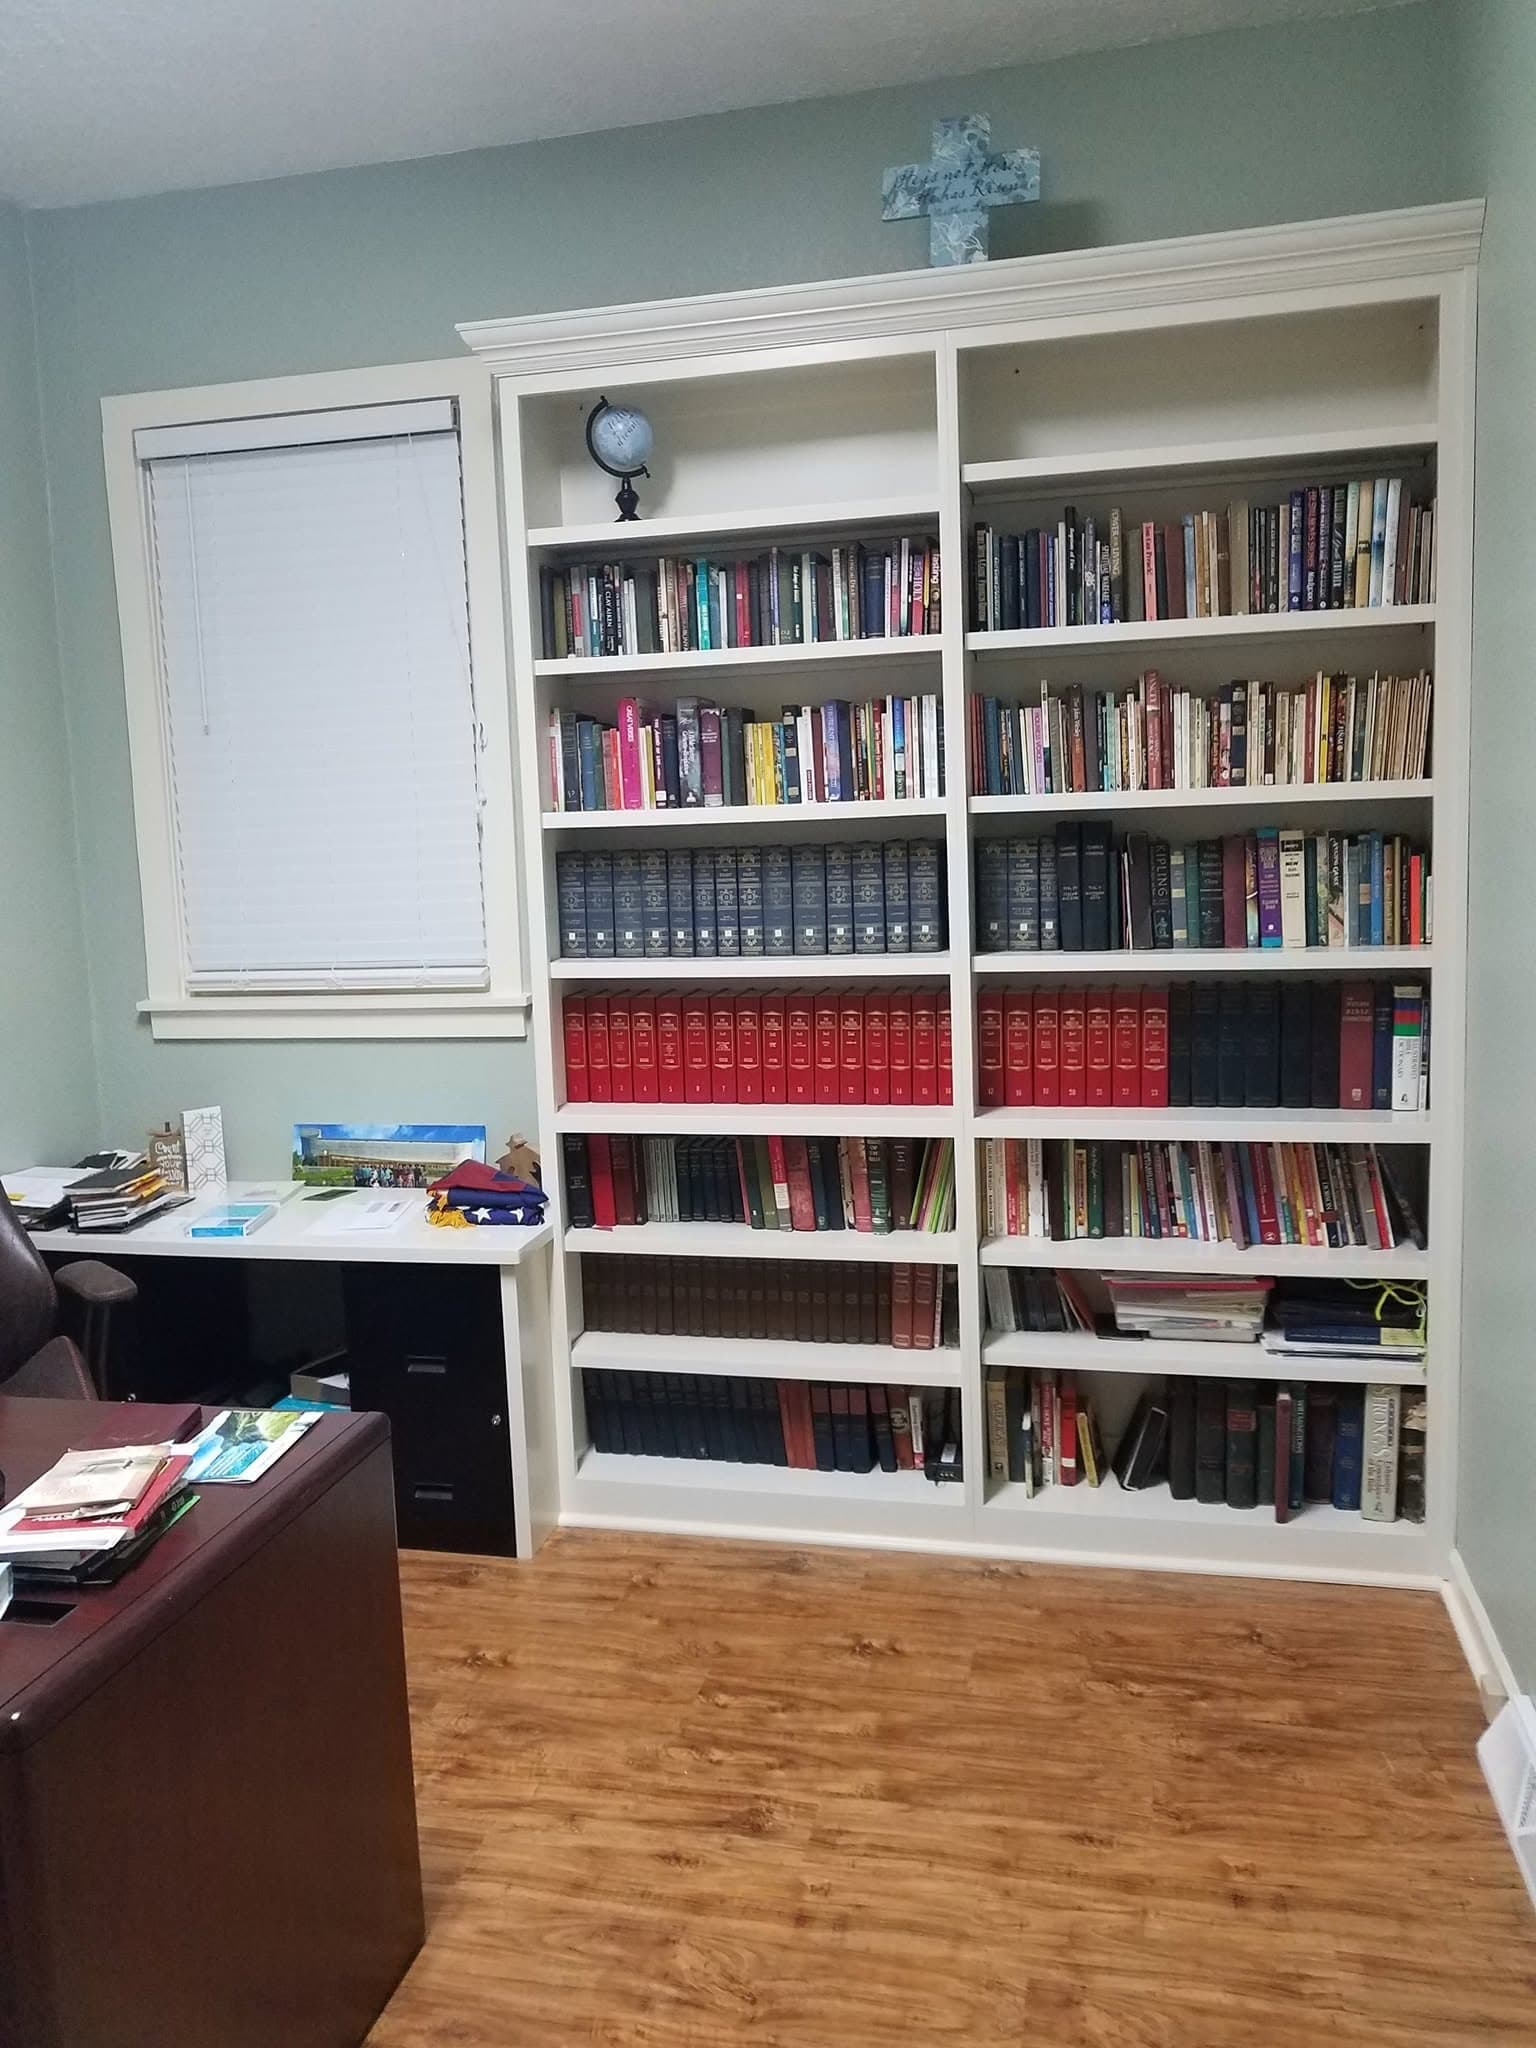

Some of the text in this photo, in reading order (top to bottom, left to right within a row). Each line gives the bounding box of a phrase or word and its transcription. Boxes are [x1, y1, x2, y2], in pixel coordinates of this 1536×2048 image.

[1112, 547, 1120, 575] LIVING
[604, 591, 613, 627] CLAY AIKEN
[1155, 845, 1168, 897] KIPLING
[1371, 1386, 1394, 1457] STRONG'S
